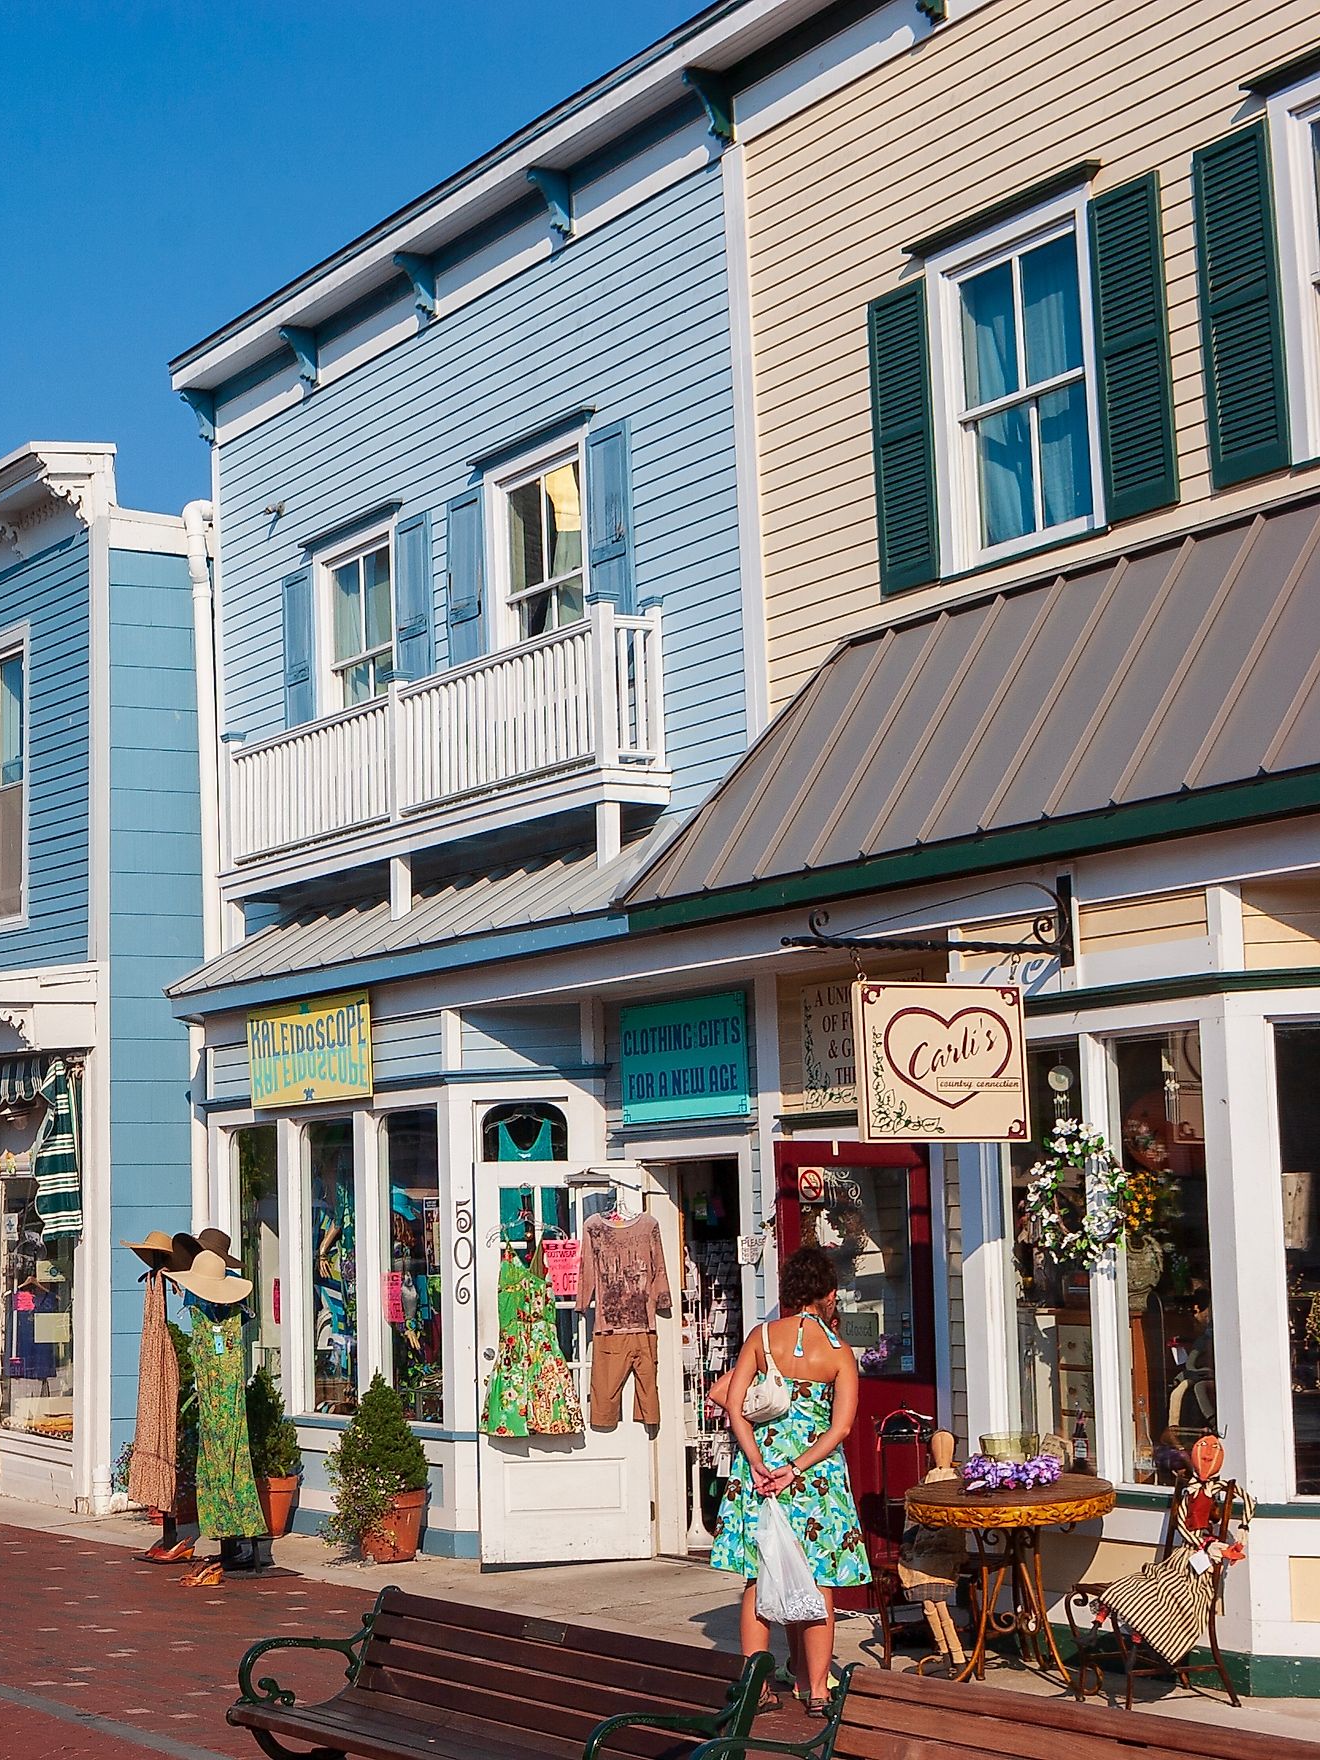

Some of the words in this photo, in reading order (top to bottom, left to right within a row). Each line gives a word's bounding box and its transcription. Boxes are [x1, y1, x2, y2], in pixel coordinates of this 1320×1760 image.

[815, 990, 823, 1007] A
[827, 985, 851, 1006] UNI
[250, 999, 366, 1060] KALEIDOSCOPE
[822, 1014, 839, 1032] OF
[623, 1023, 692, 1057] CLOTHING
[698, 1016, 741, 1048] GIFTS
[828, 1040, 838, 1059] &
[909, 1018, 997, 1080] Carli's
[628, 1072, 655, 1100] FOR
[658, 1071, 668, 1097] A
[671, 1066, 705, 1096] NEW
[709, 1063, 738, 1092] AGE
[939, 1080, 972, 1090] country
[976, 1080, 1020, 1088] connection
[453, 1199, 474, 1305] 506
[545, 1242, 577, 1250] BC
[562, 1272, 578, 1292] OFF
